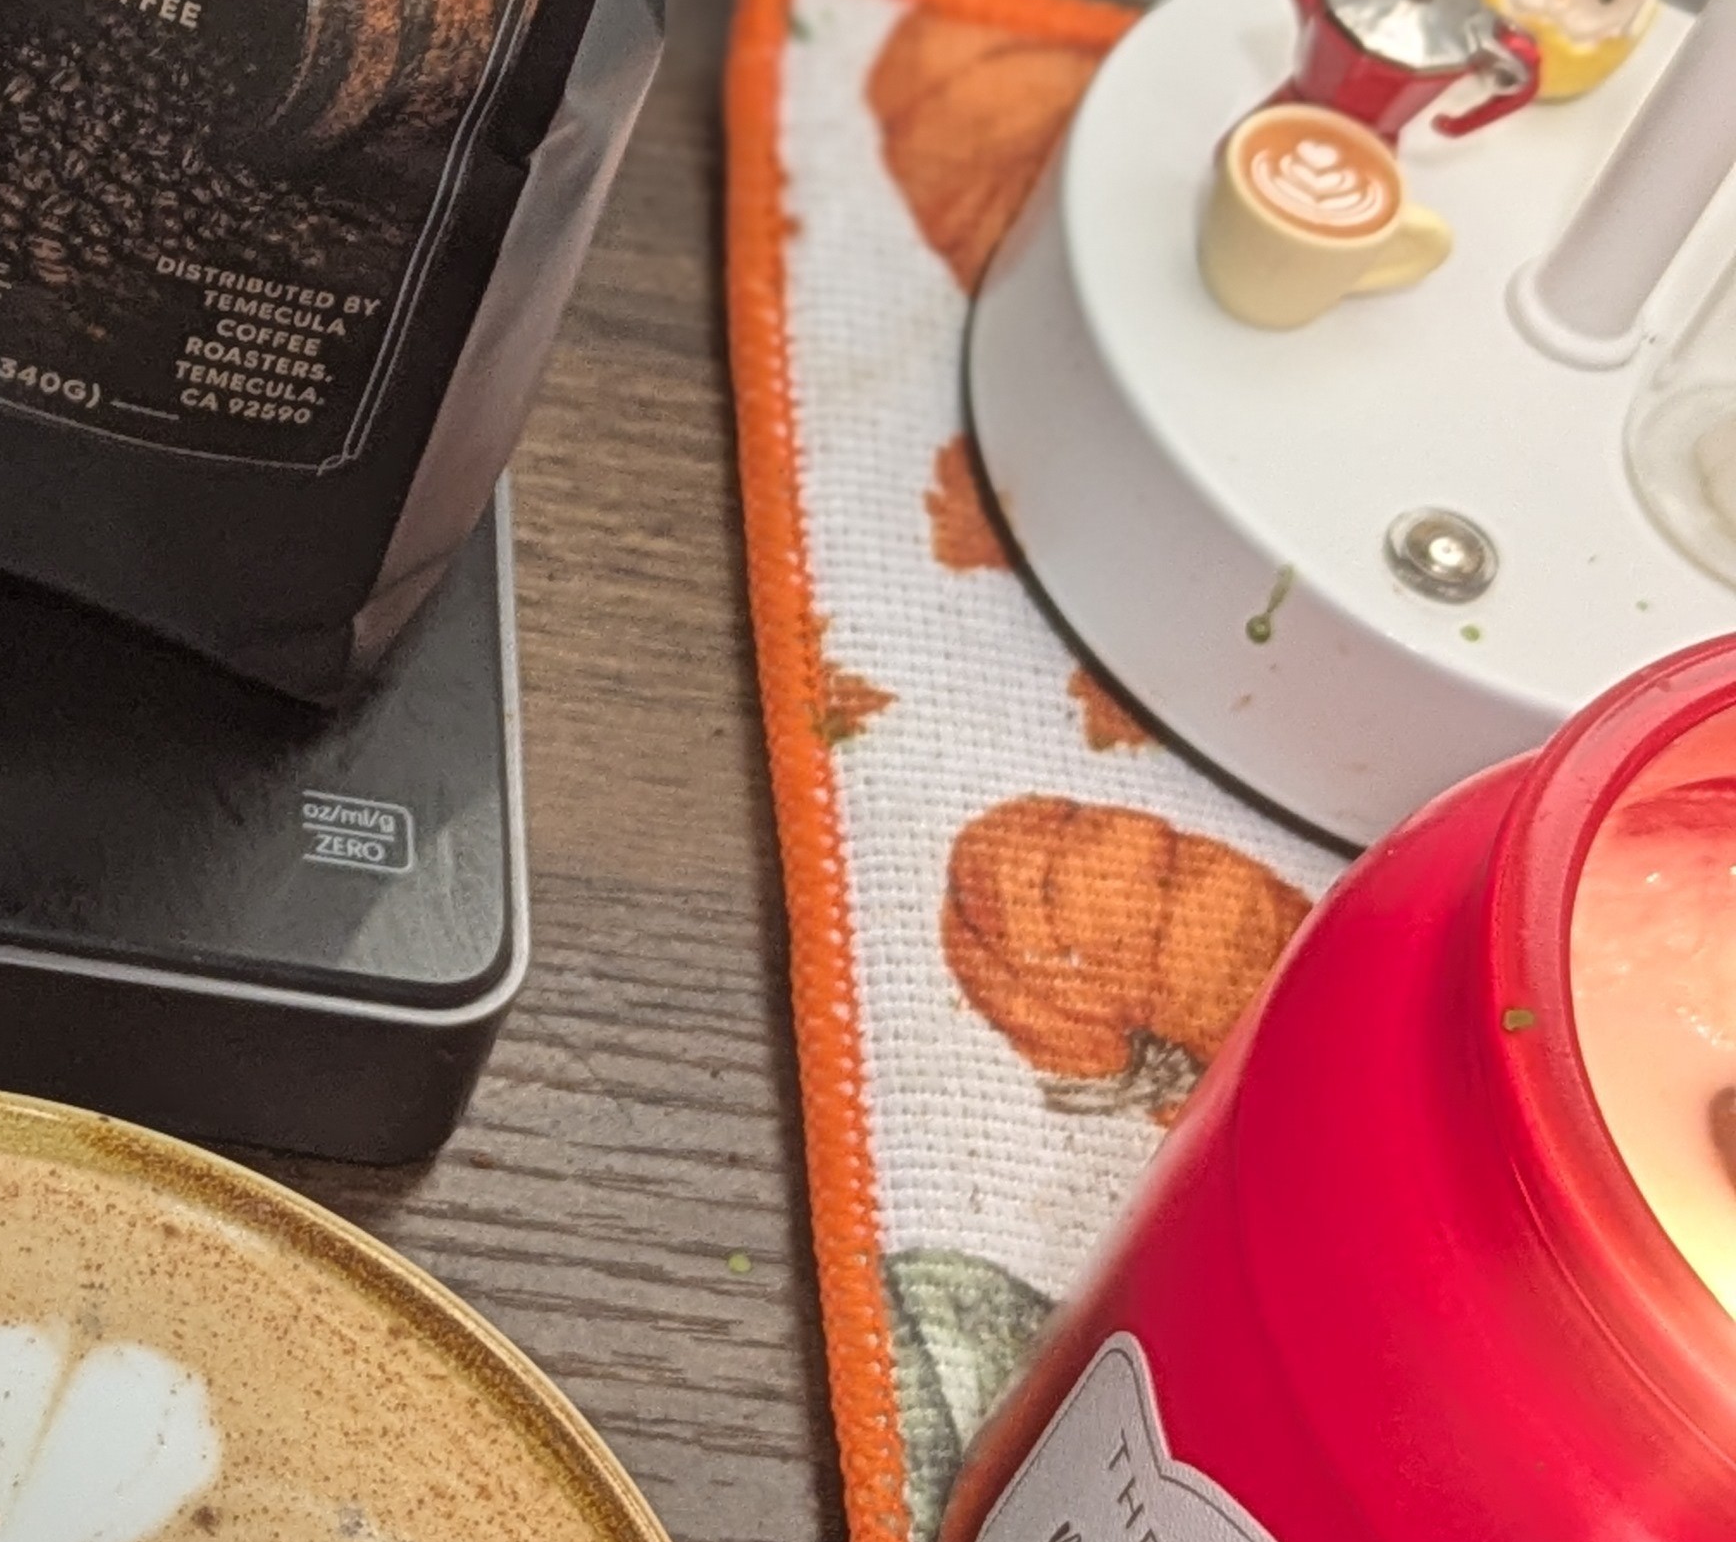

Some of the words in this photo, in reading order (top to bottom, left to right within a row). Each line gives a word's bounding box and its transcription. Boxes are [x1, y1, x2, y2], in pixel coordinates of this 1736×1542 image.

[155, 255, 336, 309] DISTRIBUTED
[342, 295, 382, 317] BY
[204, 289, 347, 336] TEMECULA
[216, 318, 322, 357] COFFEE
[179, 388, 220, 412] CA
[228, 398, 312, 425] 92590
[315, 834, 385, 863] ZERO
